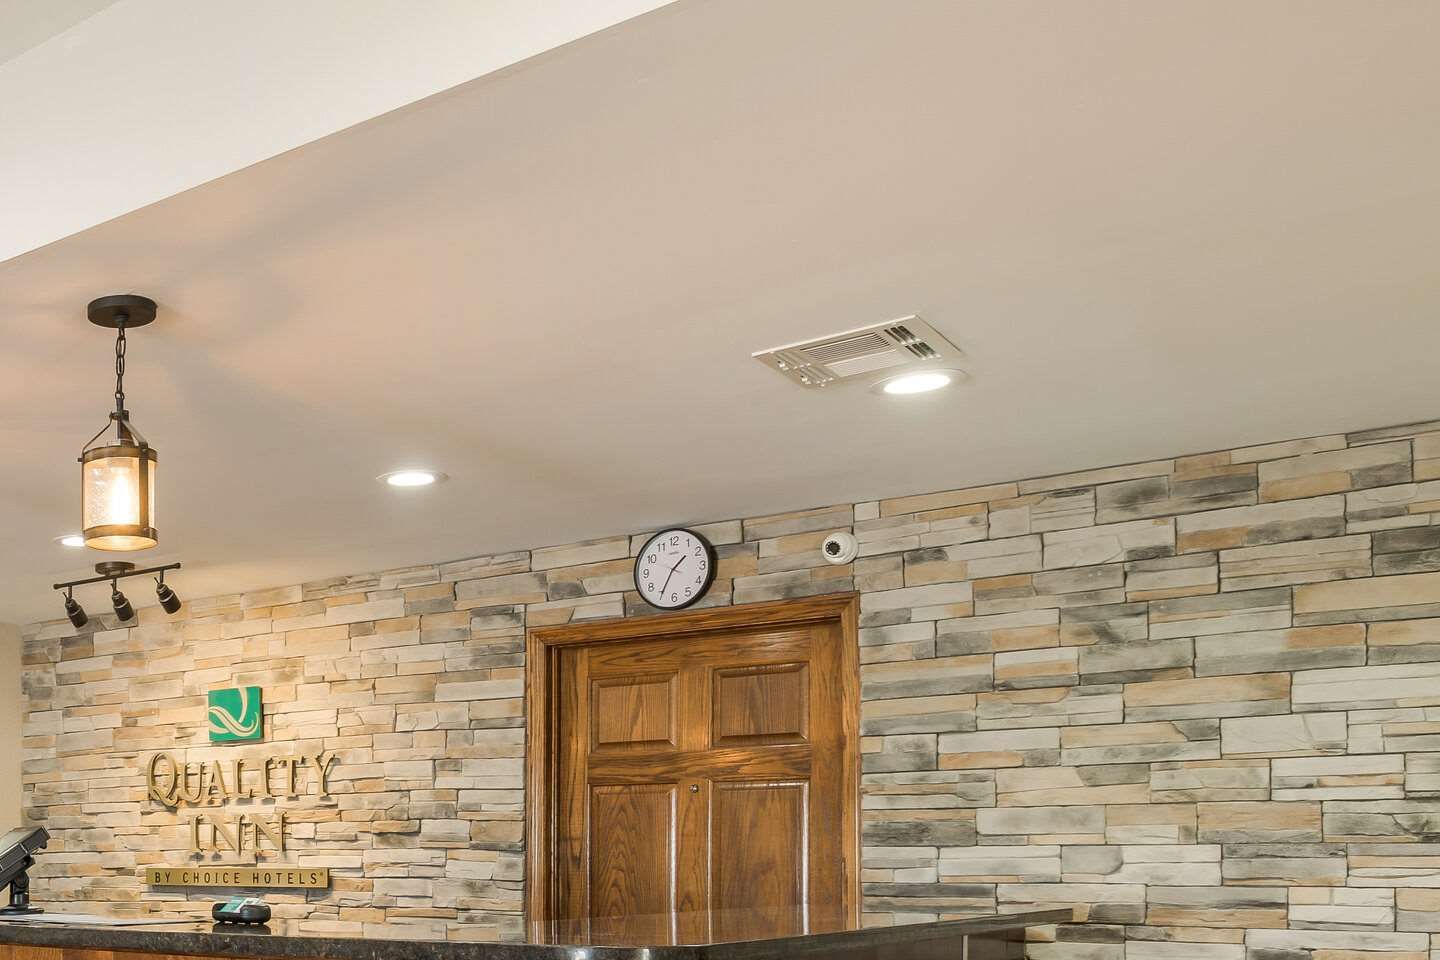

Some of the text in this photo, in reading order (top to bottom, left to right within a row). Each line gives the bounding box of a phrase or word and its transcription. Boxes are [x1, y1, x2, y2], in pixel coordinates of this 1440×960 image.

[670, 535, 680, 546] 12
[686, 538, 690, 548] 1
[657, 543, 666, 552] 11
[694, 546, 702, 556] 2
[647, 554, 657, 564] 10
[698, 560, 706, 570] 3
[643, 568, 650, 578] 9
[695, 575, 702, 584] 4
[647, 582, 655, 592] 8
[684, 587, 692, 597] 5
[671, 592, 678, 602] 6
[146, 751, 336, 807] QUALITY
[188, 811, 288, 857] INN
[154, 871, 318, 885] BY CHOICE HOTELS
